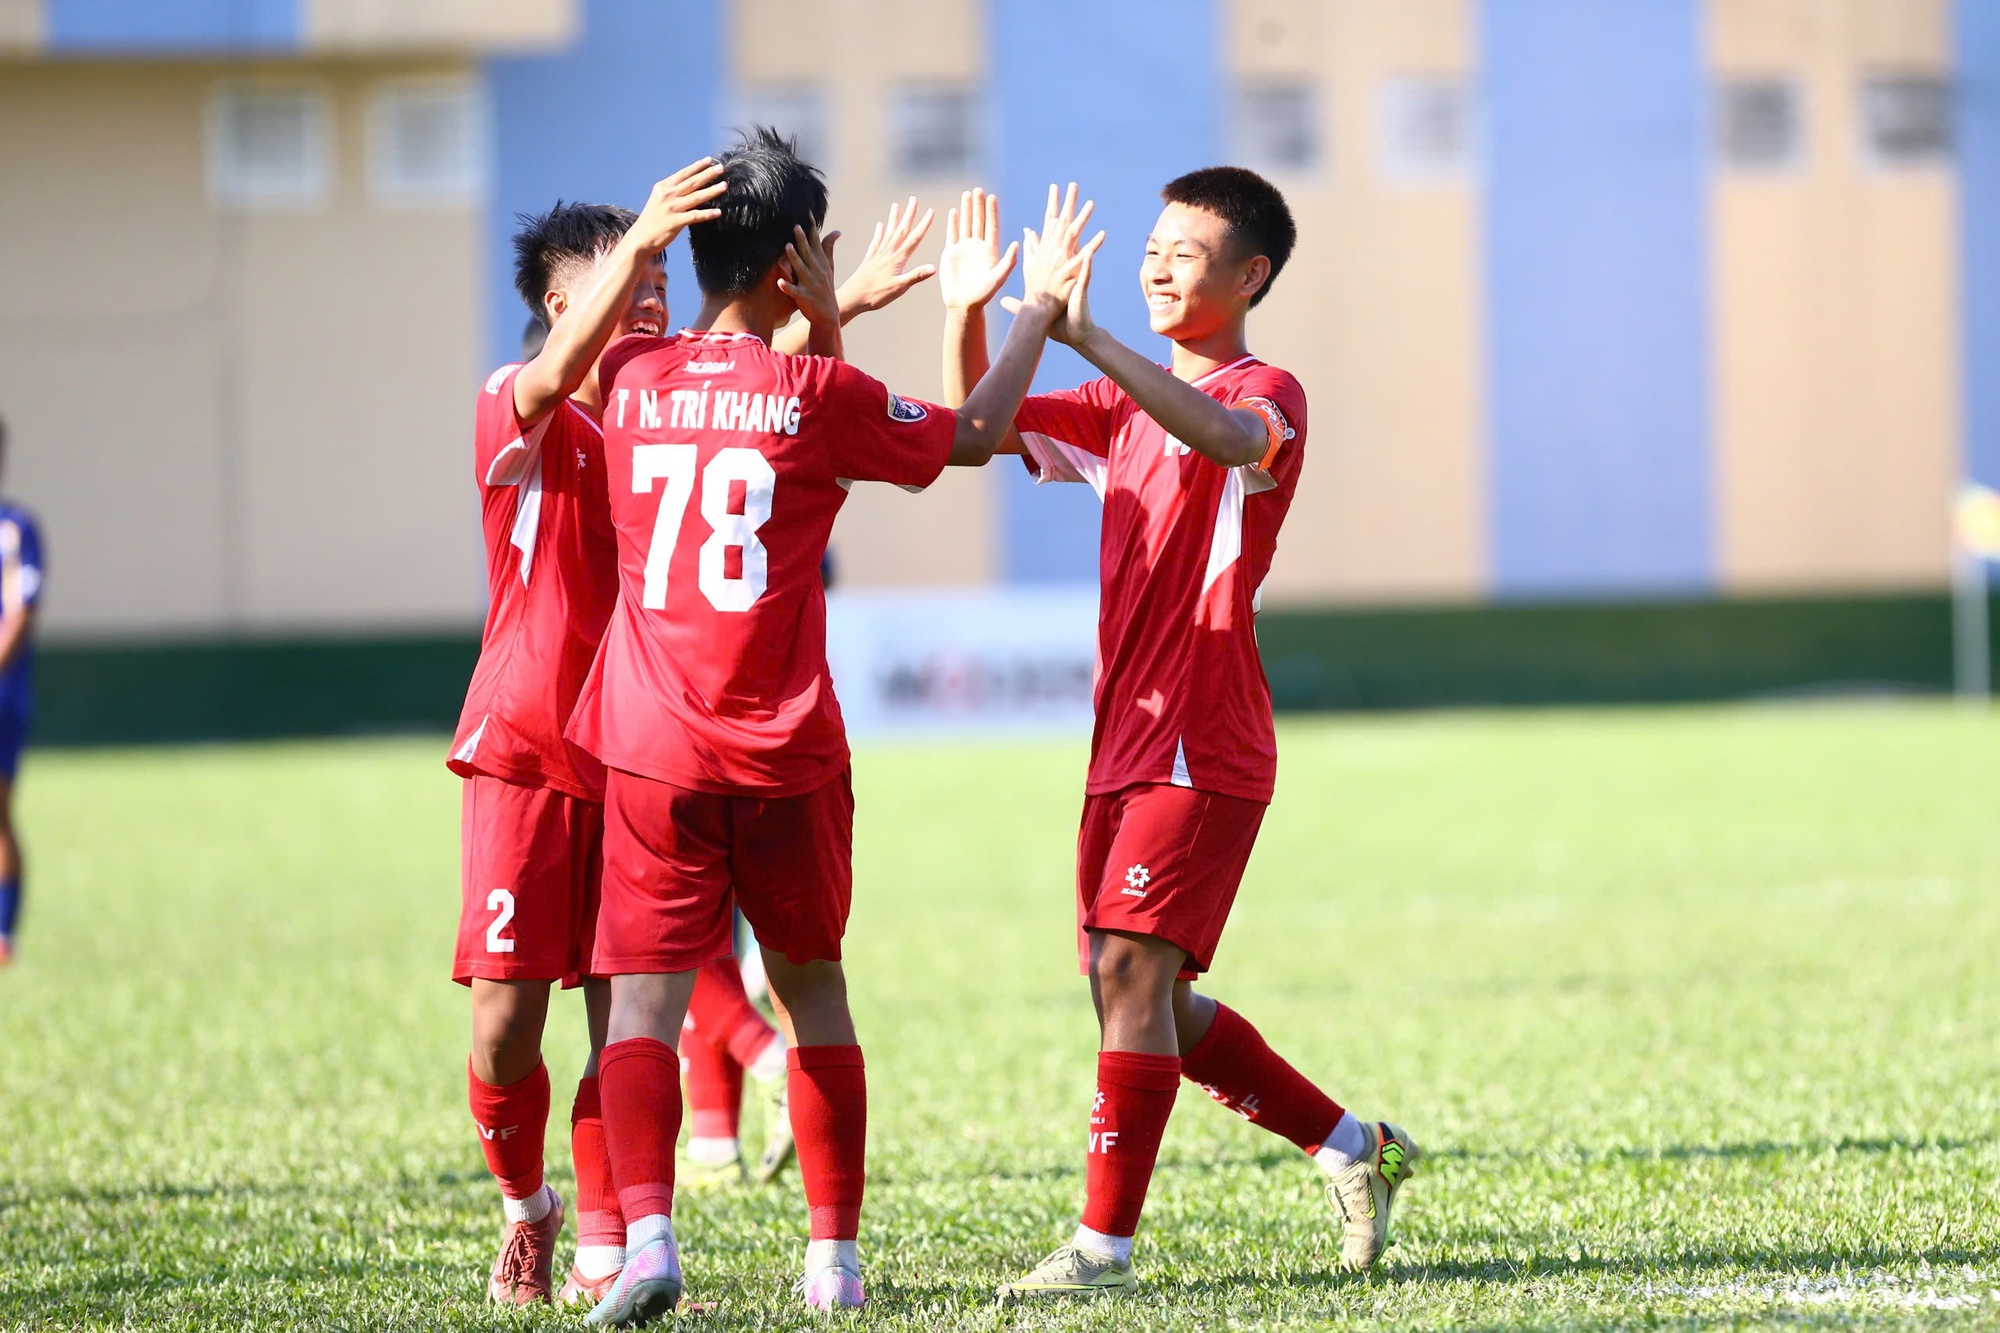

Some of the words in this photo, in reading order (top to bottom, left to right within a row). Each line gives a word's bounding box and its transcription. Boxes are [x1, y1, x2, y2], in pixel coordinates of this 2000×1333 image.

[639, 389, 662, 429] N.
[670, 380, 712, 429] TRÍ
[712, 390, 801, 436] KHANG
[631, 444, 777, 613] 78
[486, 888, 515, 953] 2
[474, 1119, 519, 1140] VF
